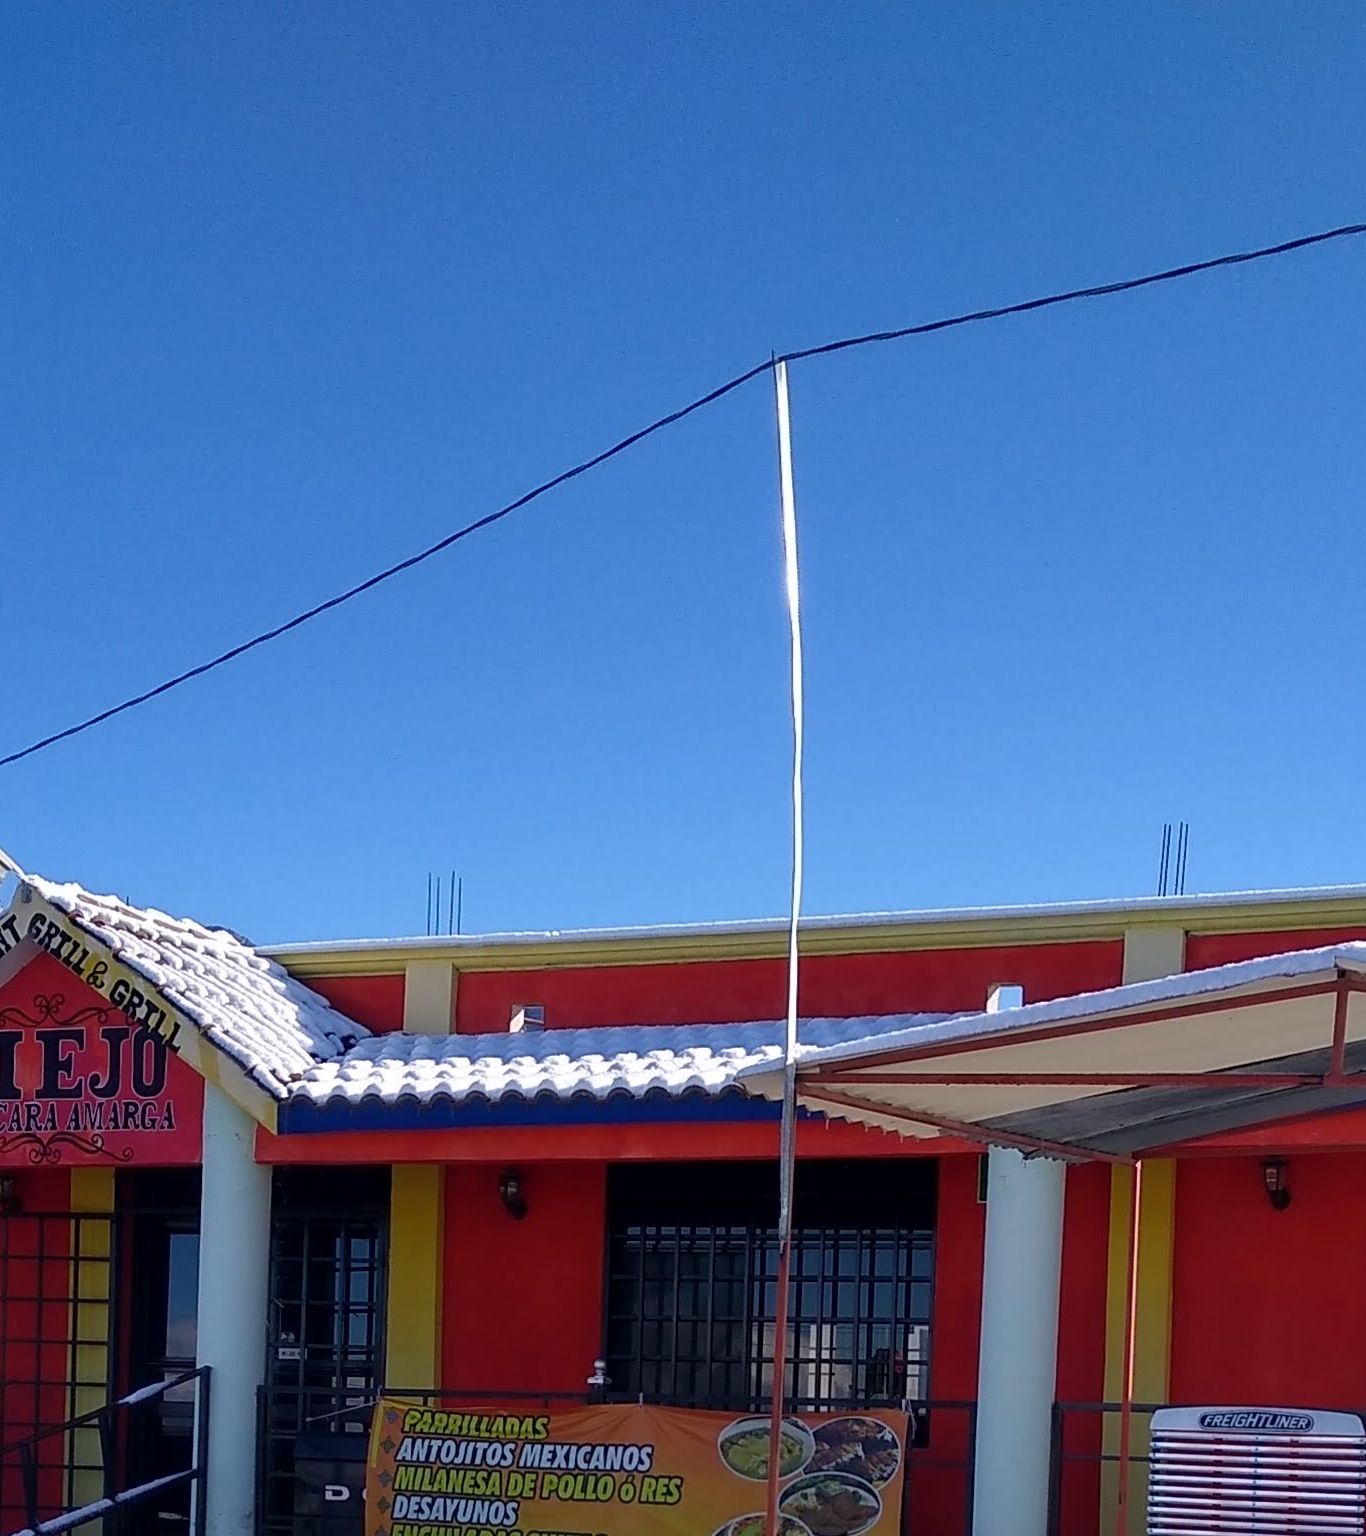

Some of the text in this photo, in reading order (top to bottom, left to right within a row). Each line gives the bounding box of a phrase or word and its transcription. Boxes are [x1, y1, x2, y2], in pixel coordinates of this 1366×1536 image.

[27, 911, 90, 977] GRILL
[85, 960, 109, 990] &
[108, 978, 182, 1054] GRILL
[64, 1099, 177, 1132] AMARGA
[402, 1408, 550, 1441] PARRILLADAS
[1203, 1413, 1309, 1429] FREIGHTLINER
[395, 1437, 653, 1473] ANTOJITOS MEXICANOS
[393, 1465, 502, 1497] MILANESA
[506, 1472, 537, 1499] DE
[541, 1474, 616, 1501] POLLO
[639, 1476, 683, 1504] RES
[392, 1496, 520, 1528] DESAYUNOS
